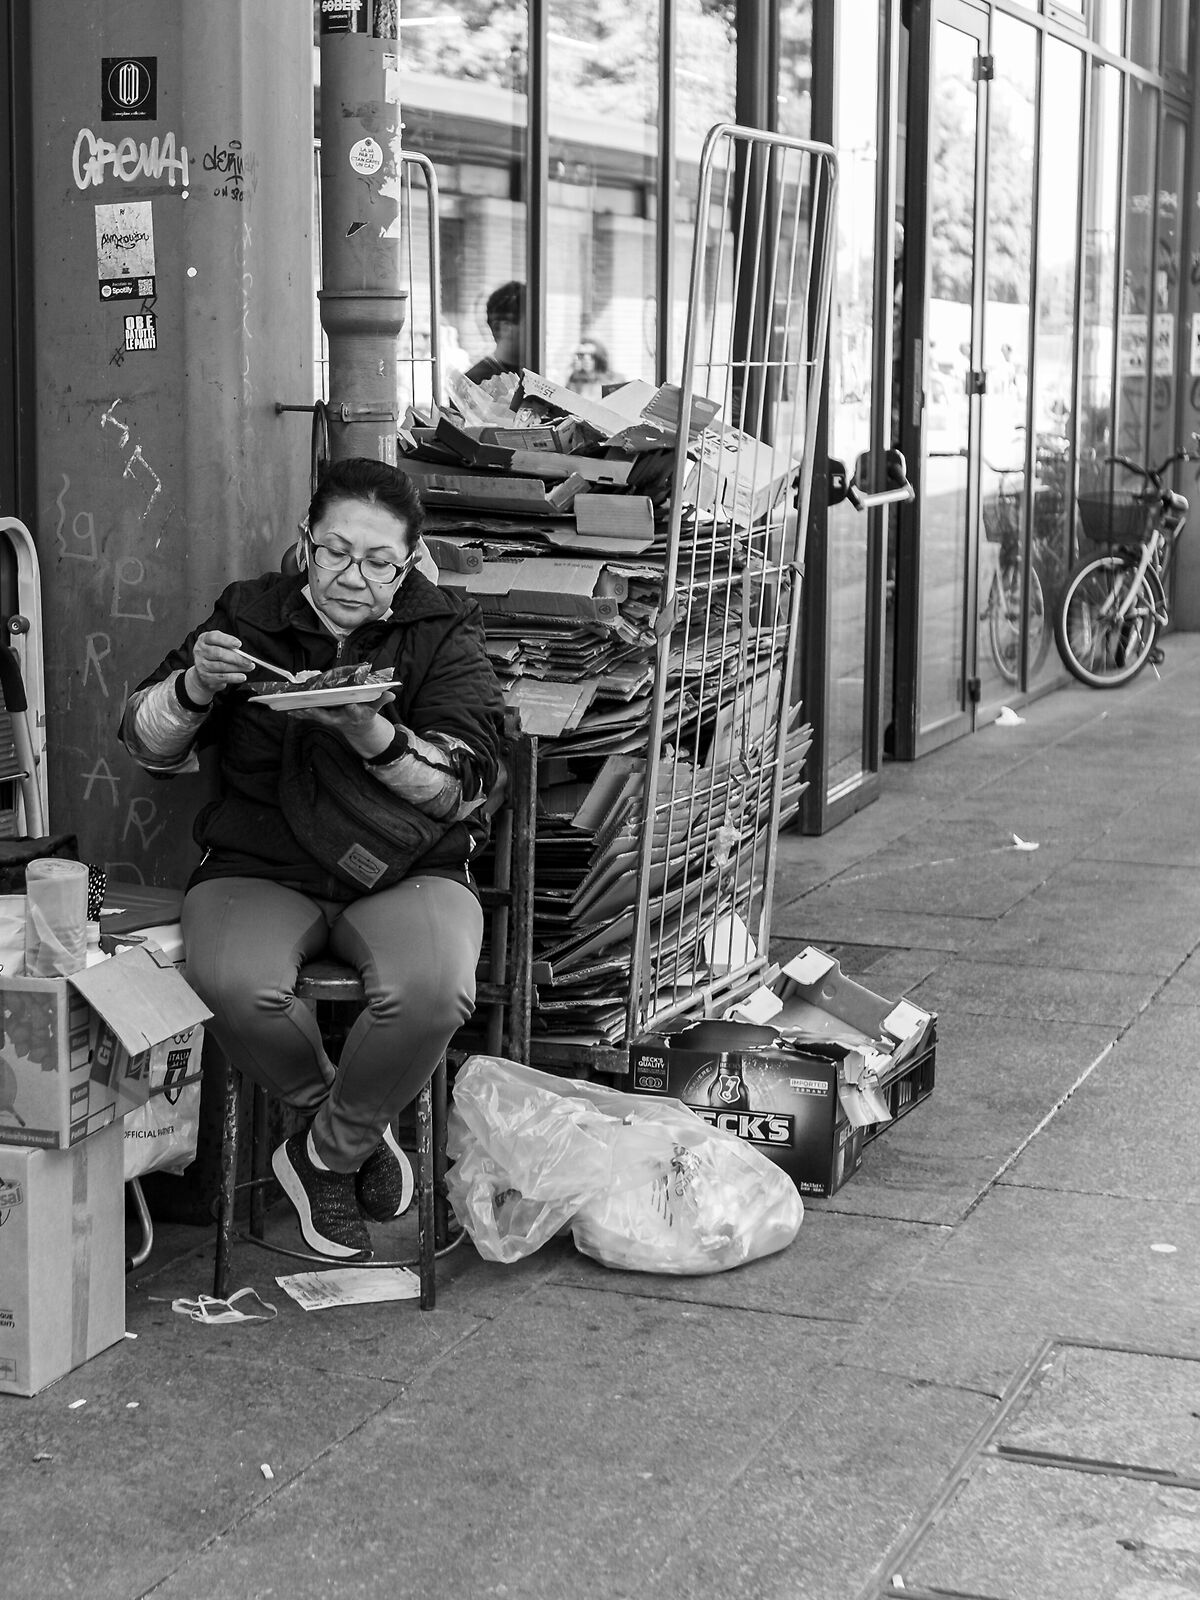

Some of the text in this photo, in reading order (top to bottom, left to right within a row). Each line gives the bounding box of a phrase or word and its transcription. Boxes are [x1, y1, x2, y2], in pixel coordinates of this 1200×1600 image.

[112, 286, 133, 295] Spotify
[125, 328, 155, 340] DA TUTTE
[126, 337, 156, 350] LE PARTI
[638, 1060, 665, 1069] QUALITY
[641, 1055, 664, 1064] BECK'S
[792, 1079, 827, 1089] IMPORTED
[695, 1112, 790, 1142] ECK'S
